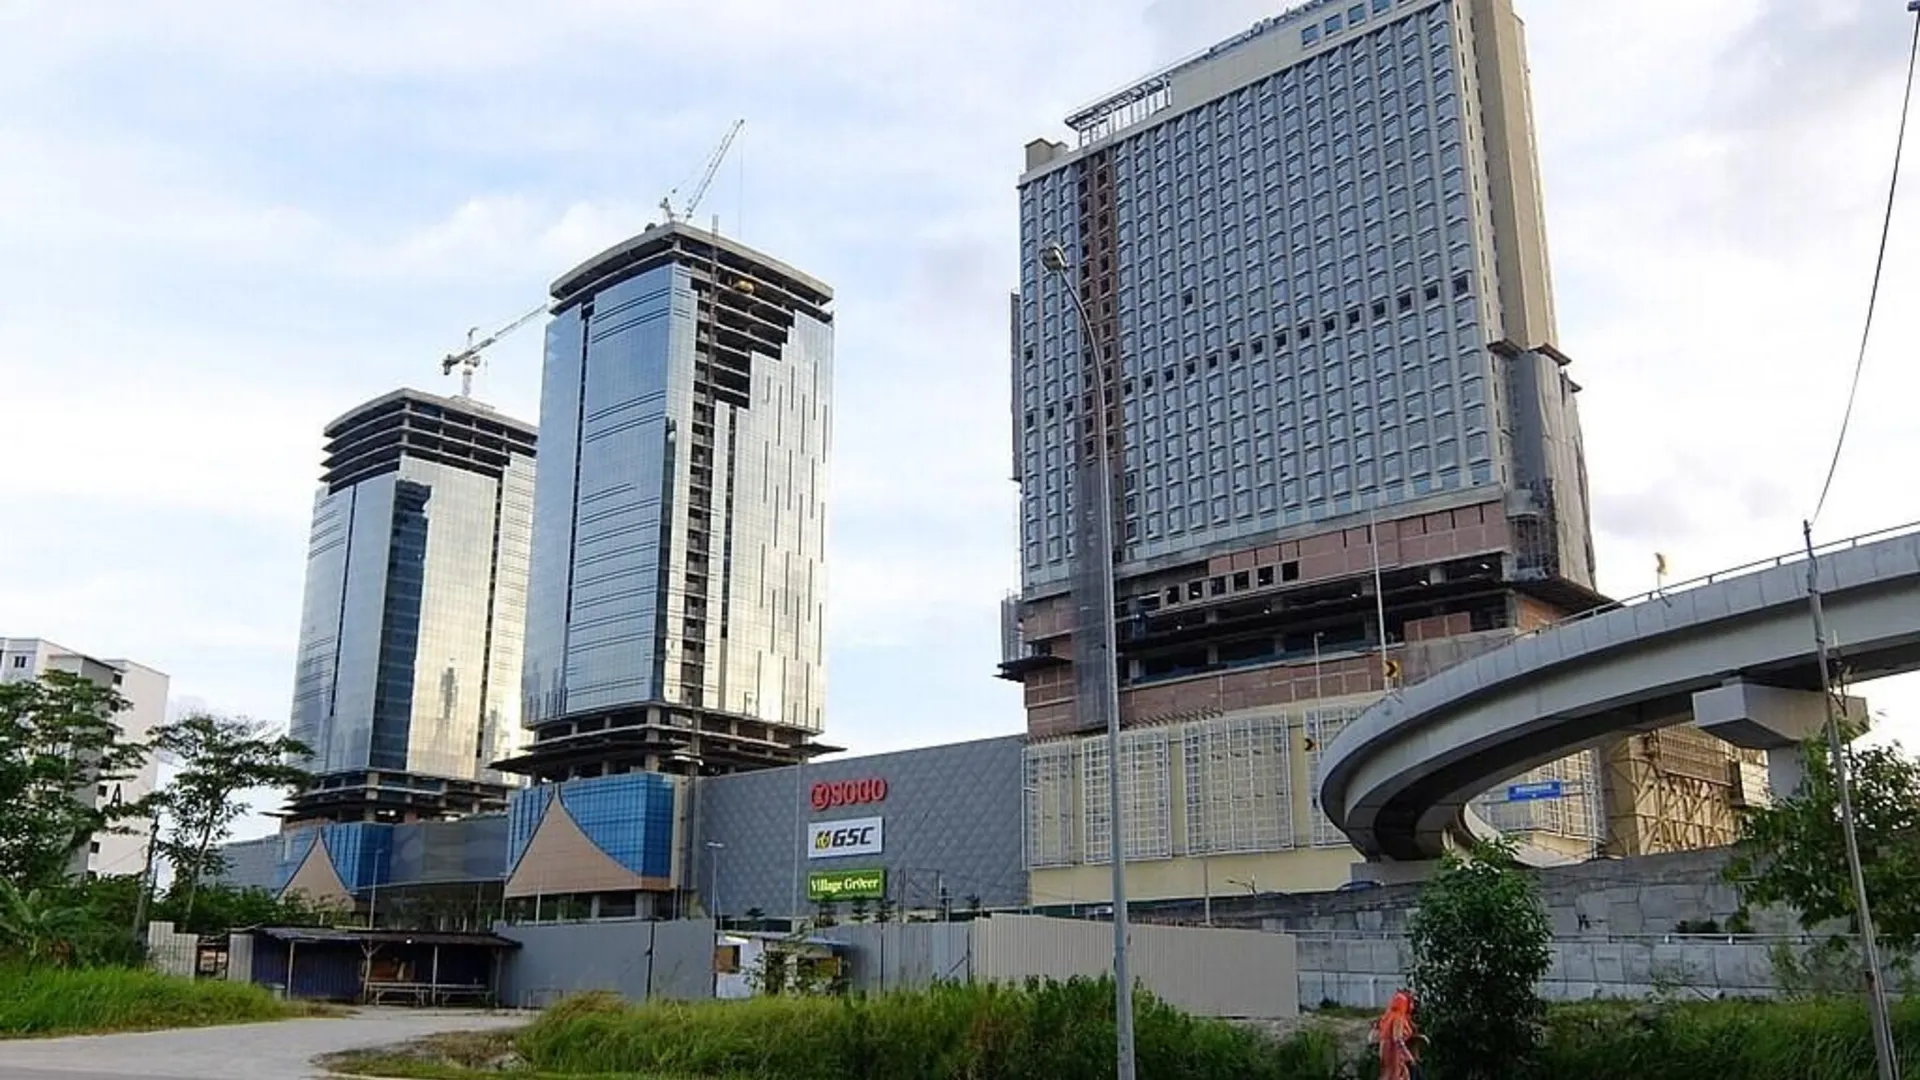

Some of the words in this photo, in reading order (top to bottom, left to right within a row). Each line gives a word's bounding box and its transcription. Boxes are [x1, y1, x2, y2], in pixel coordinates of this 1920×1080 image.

[110, 783, 121, 808] A
[831, 779, 887, 805] SOGO
[832, 827, 875, 847] GSC
[811, 878, 842, 893] Village
